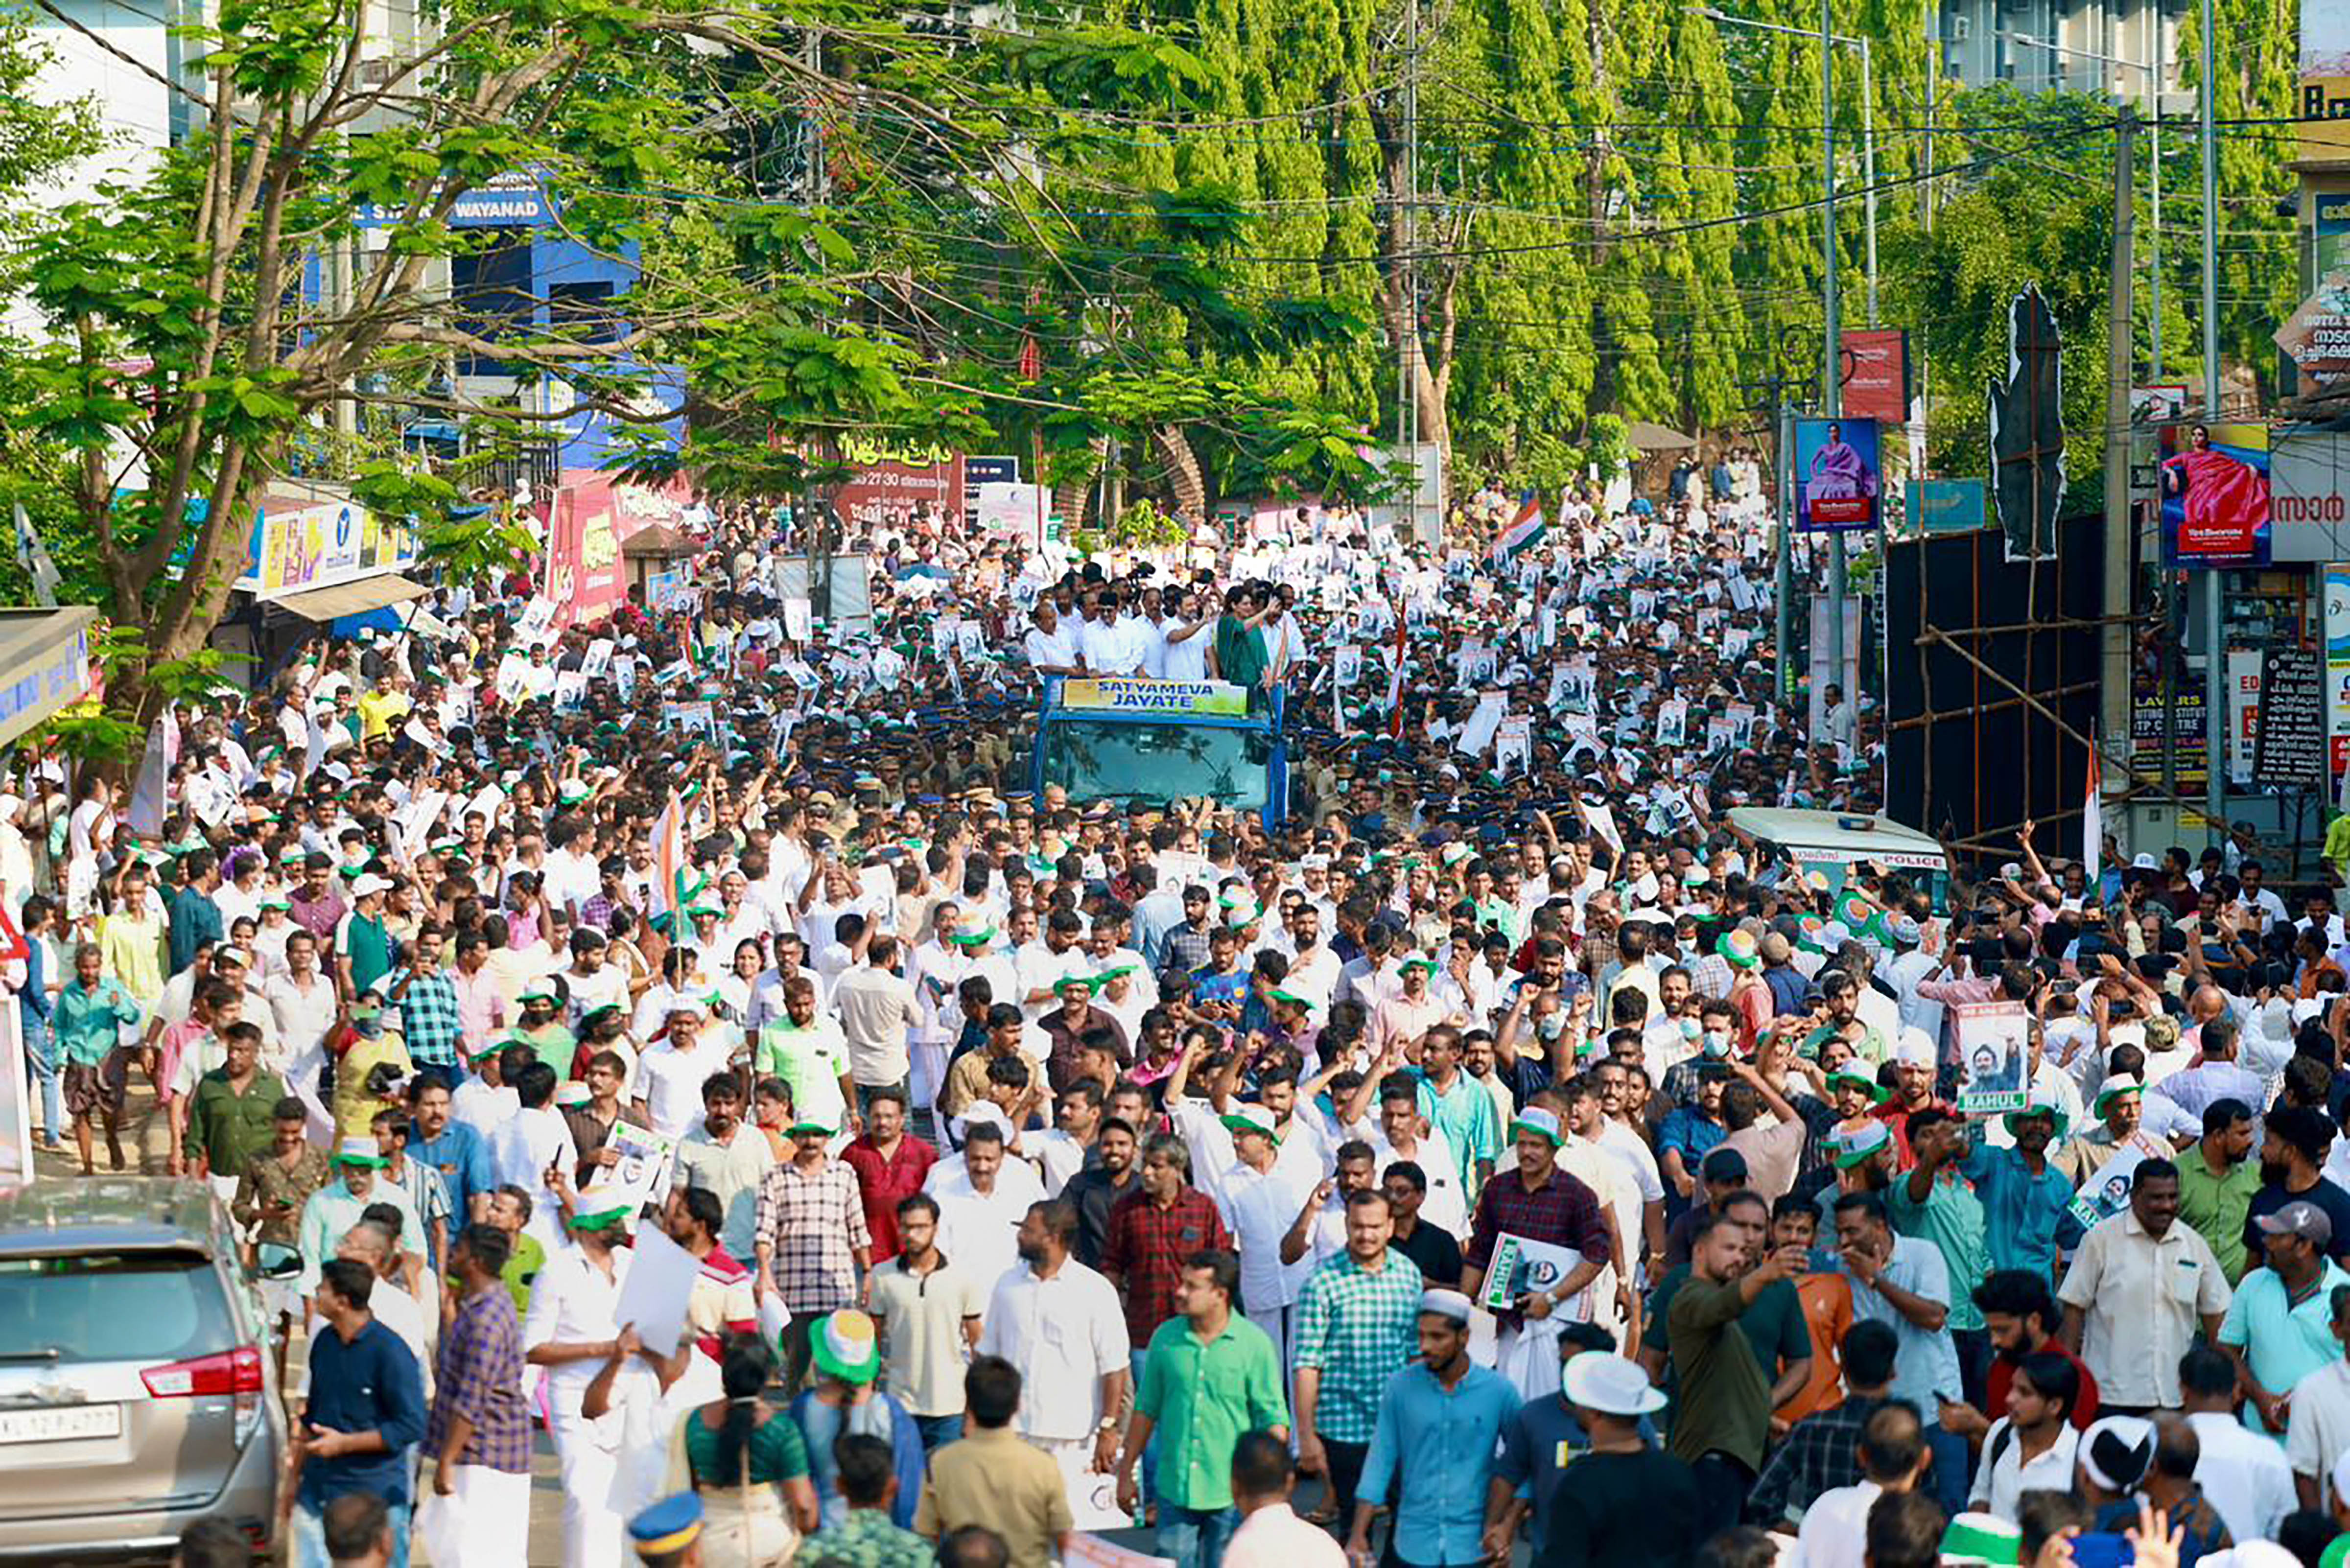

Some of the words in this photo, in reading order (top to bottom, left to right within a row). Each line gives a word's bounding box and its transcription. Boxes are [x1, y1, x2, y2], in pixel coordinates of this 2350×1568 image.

[454, 202, 539, 218] WAYANAD
[1098, 681, 1213, 695] SATYAMEVA
[1113, 693, 1193, 708] JAYATE
[1884, 855, 1942, 867] POLICE
[1968, 1093, 2017, 1109] RAHUL
